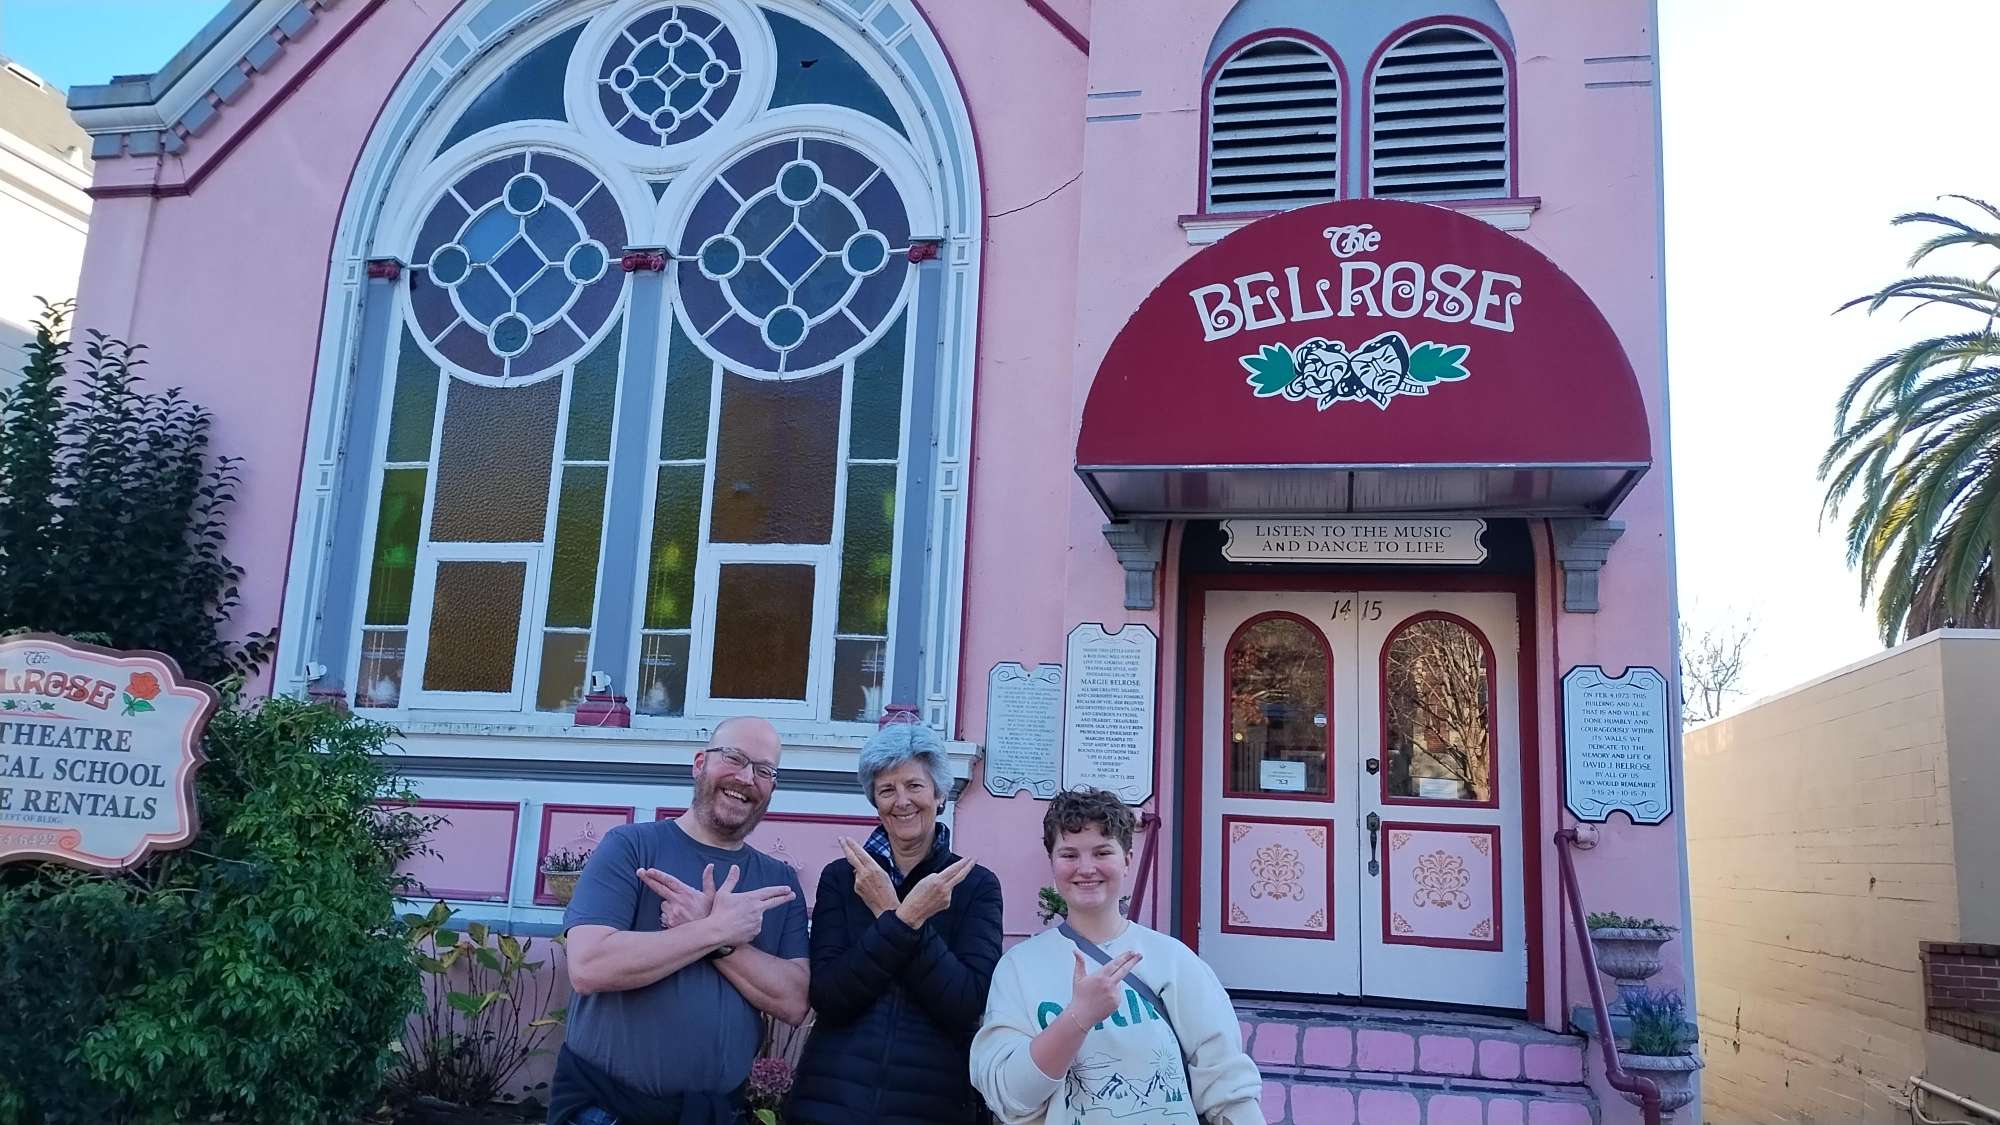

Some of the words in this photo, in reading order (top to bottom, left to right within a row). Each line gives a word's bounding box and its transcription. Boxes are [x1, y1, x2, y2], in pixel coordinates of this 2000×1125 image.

[1323, 223, 1381, 259] The
[1189, 261, 1522, 342] BELROSE
[1255, 525, 1316, 538] LISTEN
[1321, 525, 1345, 538] TO
[1351, 526, 1388, 538] THE
[1395, 526, 1452, 539] MUSIC
[1262, 539, 1301, 552] AND
[1307, 540, 1369, 553] DANCE
[1374, 541, 1399, 553] TO
[1405, 541, 1445, 553] LIFE
[24, 650, 51, 666] The
[0, 721, 133, 753] THEATRE
[53, 758, 165, 787] SCHOOL
[1583, 761, 1606, 769] DAVID
[1615, 762, 1653, 771] BELROSE
[21, 789, 158, 820] RENTALS
